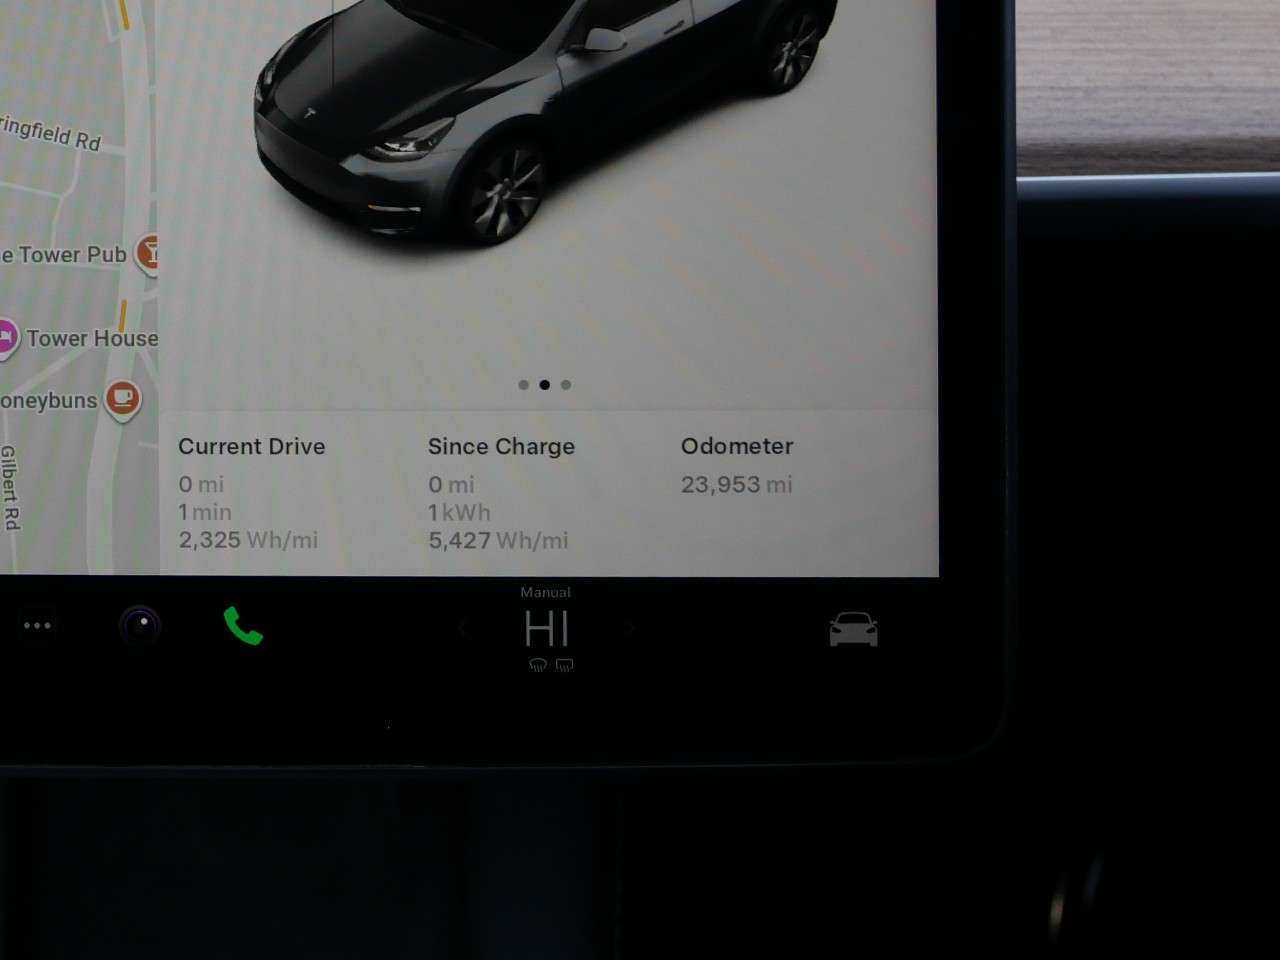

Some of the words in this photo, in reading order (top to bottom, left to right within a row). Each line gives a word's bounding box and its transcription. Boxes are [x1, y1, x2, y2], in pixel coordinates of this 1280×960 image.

[76, 131, 101, 152] Rd
[20, 246, 80, 263] Tower
[87, 245, 127, 263] Pub
[27, 329, 88, 347] Tower
[94, 329, 159, 347] House
[178, 437, 262, 455] Current
[269, 436, 326, 455] Drive
[428, 436, 489, 455] Since
[495, 436, 576, 459] Charge
[681, 436, 794, 455] Odometer
[1, 445, 18, 502] Gilbert
[178, 475, 193, 494] 0
[198, 475, 225, 493] mi
[428, 475, 443, 494] 0
[448, 475, 475, 493] mi
[681, 475, 761, 497] 23,953
[767, 474, 793, 493] mi
[5, 506, 21, 531] Rd
[179, 503, 187, 521] 1
[193, 502, 232, 521] min
[429, 503, 437, 521] 1
[442, 502, 491, 521] kWh
[179, 531, 241, 552] 2,325
[247, 530, 319, 551] Wh/mi
[429, 531, 491, 552] 5,427
[496, 530, 569, 551] Wh/mi
[521, 586, 572, 599] Manual
[525, 609, 568, 647] HI
